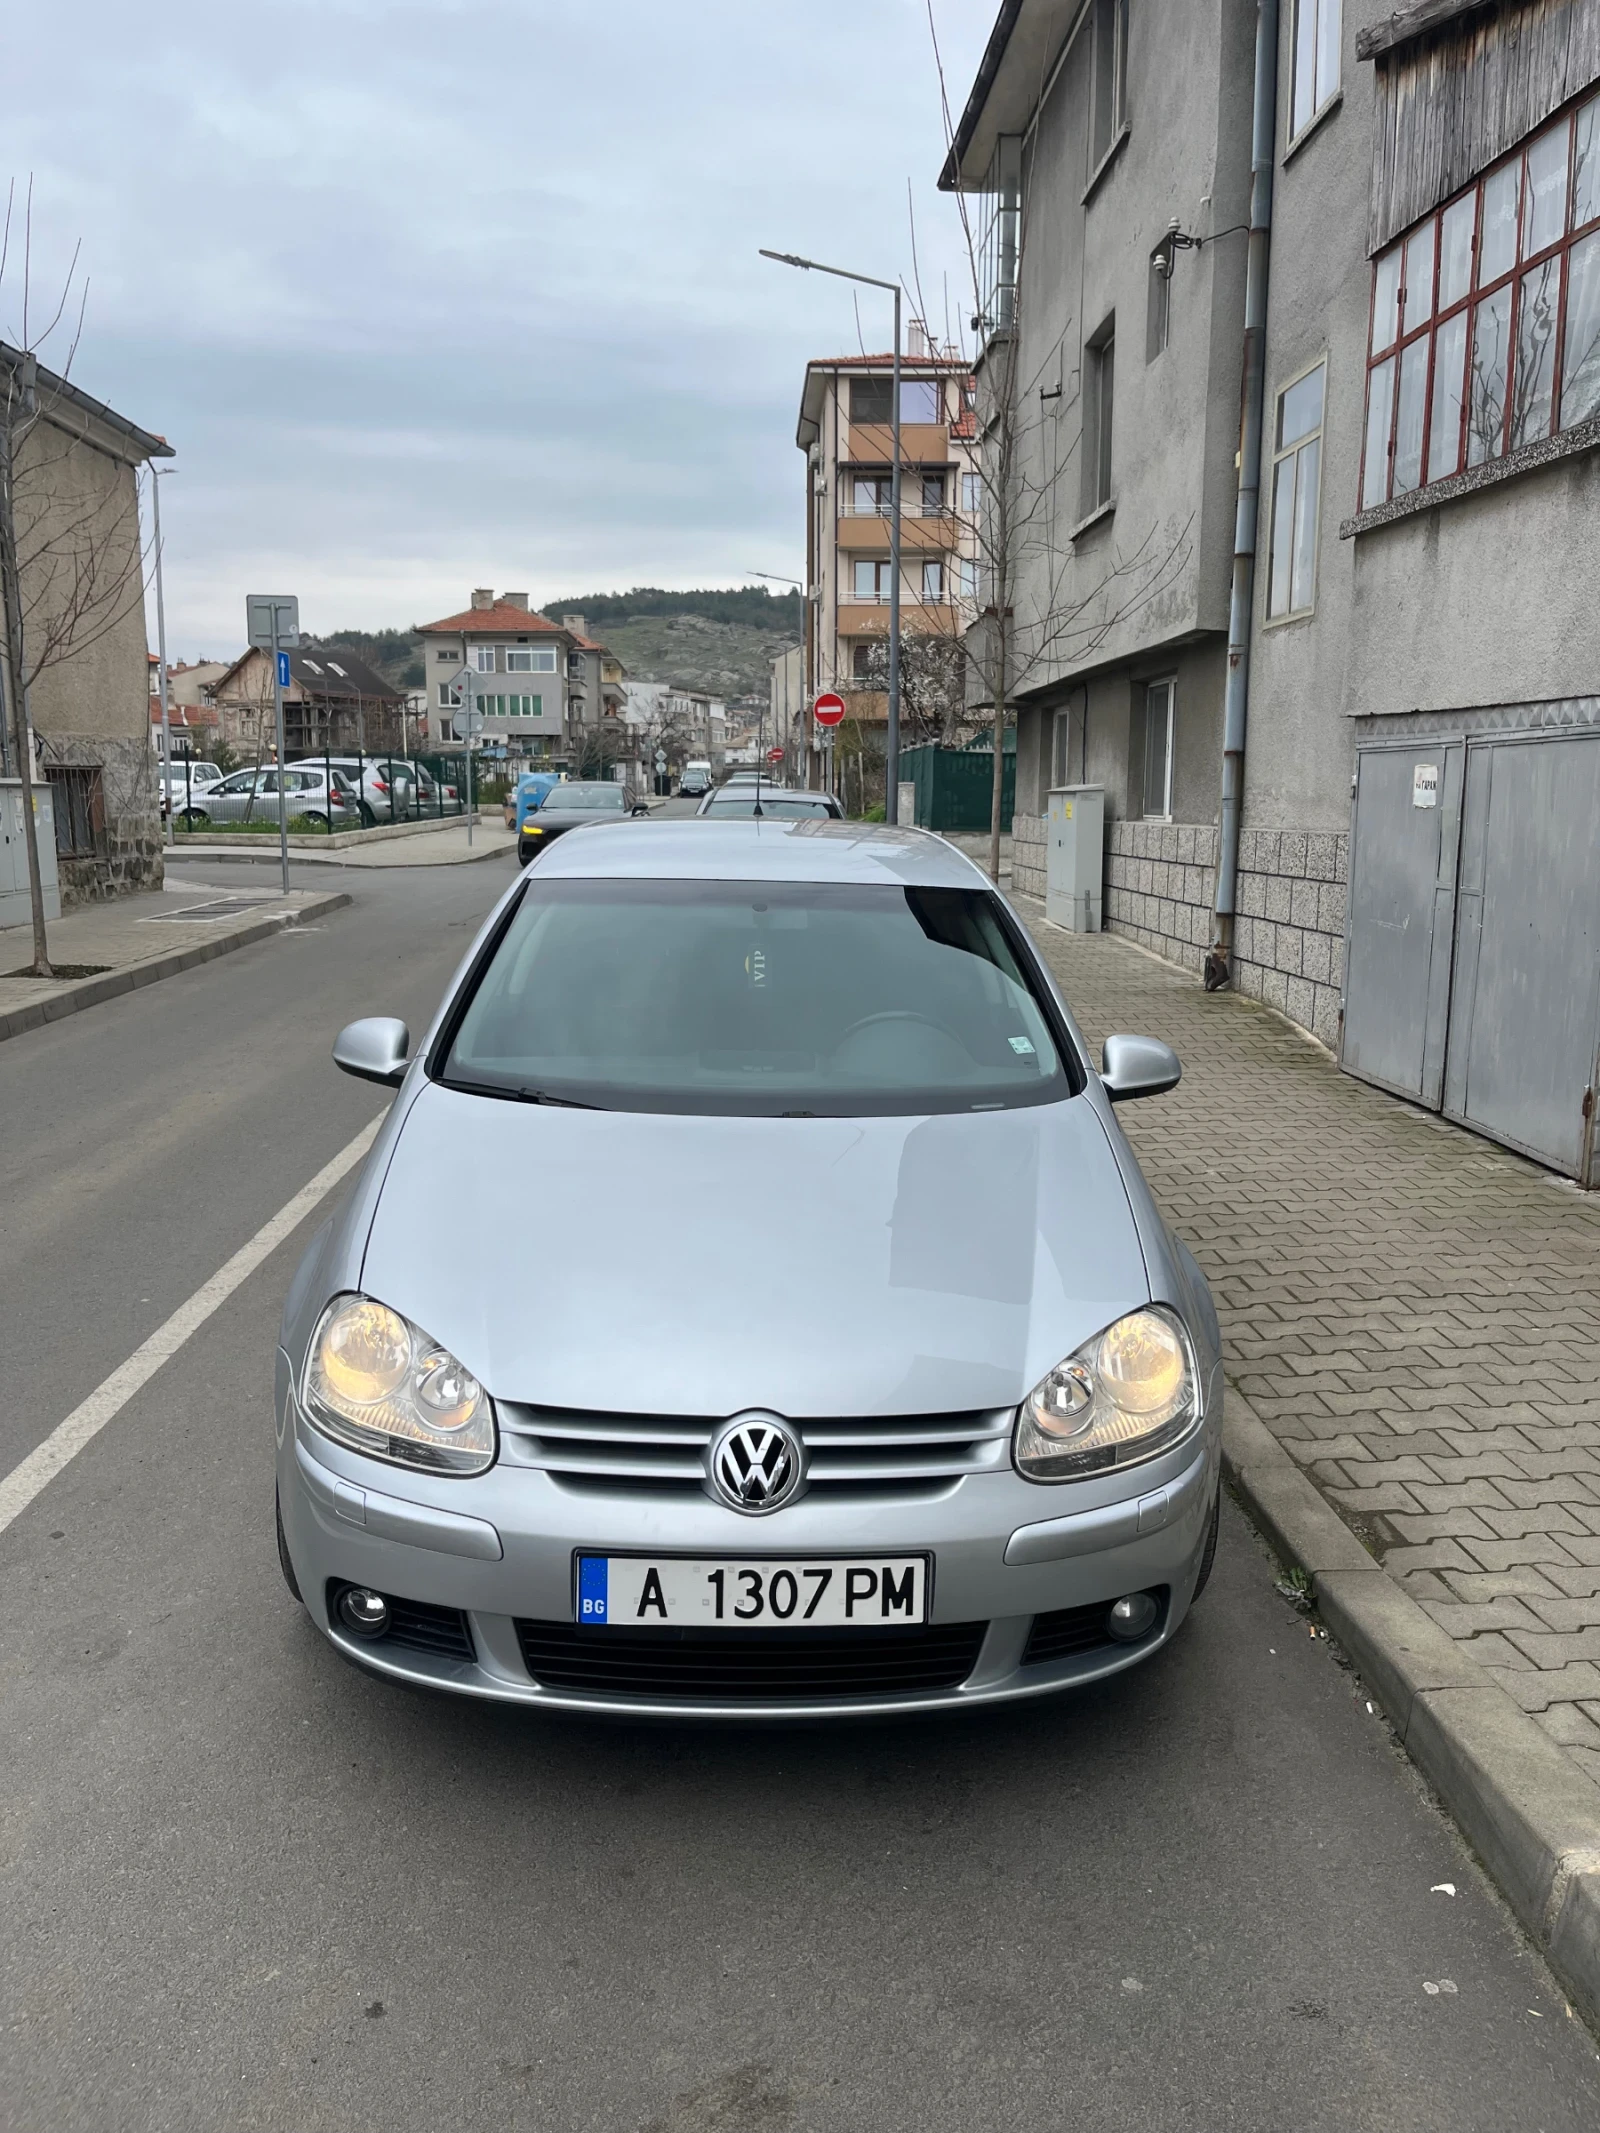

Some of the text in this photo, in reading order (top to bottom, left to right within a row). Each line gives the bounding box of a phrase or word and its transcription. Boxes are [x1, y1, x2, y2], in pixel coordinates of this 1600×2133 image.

[754, 950, 765, 981] VIP
[583, 1598, 605, 1614] BG
[636, 1566, 915, 1619] A 1307 PM
